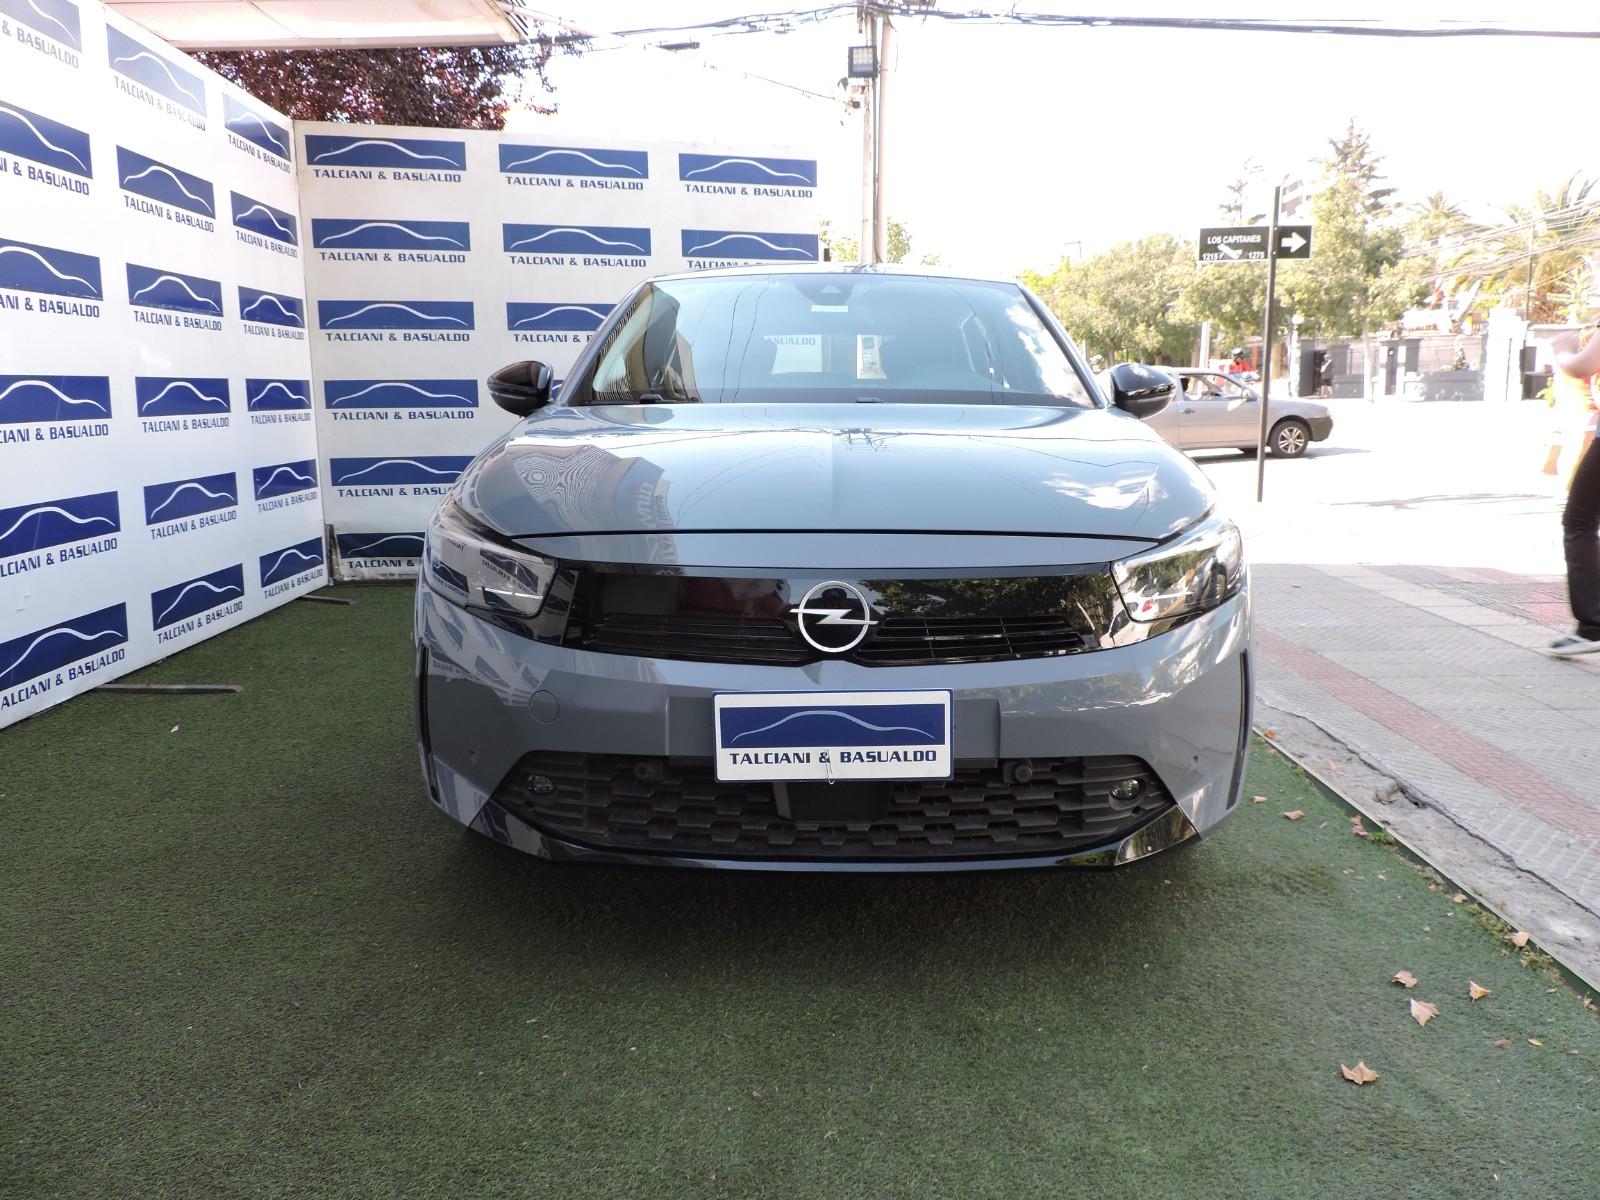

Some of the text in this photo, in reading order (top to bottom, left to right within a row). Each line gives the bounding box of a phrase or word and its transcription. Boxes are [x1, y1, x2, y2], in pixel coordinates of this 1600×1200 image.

[17, 27, 79, 69] BASUALDO
[114, 75, 206, 132] TALCIANI & BASUALDO
[228, 134, 290, 174] TALCIANI & BASUALDO
[13, 161, 22, 177] &
[28, 165, 90, 196] BASUALDO
[313, 169, 461, 183] TALCIANI & BASUALDO
[506, 176, 644, 191] TALCIANI & BASUALDO
[685, 184, 813, 198] TALCIANI & BASUALDO
[124, 195, 214, 233] TALCIANI & BASUALDO
[236, 230, 297, 258] TALCIANI & BASUALDO
[1207, 235, 1261, 244] LOS CAPITANES
[320, 252, 466, 263] TALCIANI & BASUALDO
[510, 255, 646, 268] TALCIANI & BASUALDO
[1248, 251, 1265, 259] 1275
[25, 297, 34, 311] &
[39, 299, 100, 318] BASUALDO
[134, 310, 222, 331] TALCIANI & BASUALDO
[243, 323, 304, 340] TALCIANI & BASUALDO
[326, 332, 470, 342] TALCIANI & BASUALDO
[514, 333, 567, 343] TALCIANI
[572, 334, 581, 343] &
[250, 412, 311, 425] TALCIANI & BASUALDO
[332, 410, 474, 421] TALCIANI & BASUALDO
[35, 428, 44, 441] &
[50, 424, 109, 440] BASUALDO
[142, 417, 230, 434] TALCIANI & BASUALDO
[338, 487, 451, 498] TALCIANI & BASU
[257, 491, 317, 513] TALCIANI & BASUALDO
[151, 510, 237, 541] TALCIANI & BASUALDO
[0, 537, 118, 578] LCIANI & BASUALDO
[347, 560, 402, 569] TALCIANI
[264, 568, 323, 600] TALCIANI & BASUALDO
[157, 600, 243, 645] TALCIANI & BASUALDO
[1, 648, 125, 710] ALCIANI & BASUALDO
[730, 752, 811, 765] TALCIANI
[840, 750, 937, 763] BASUALDO
